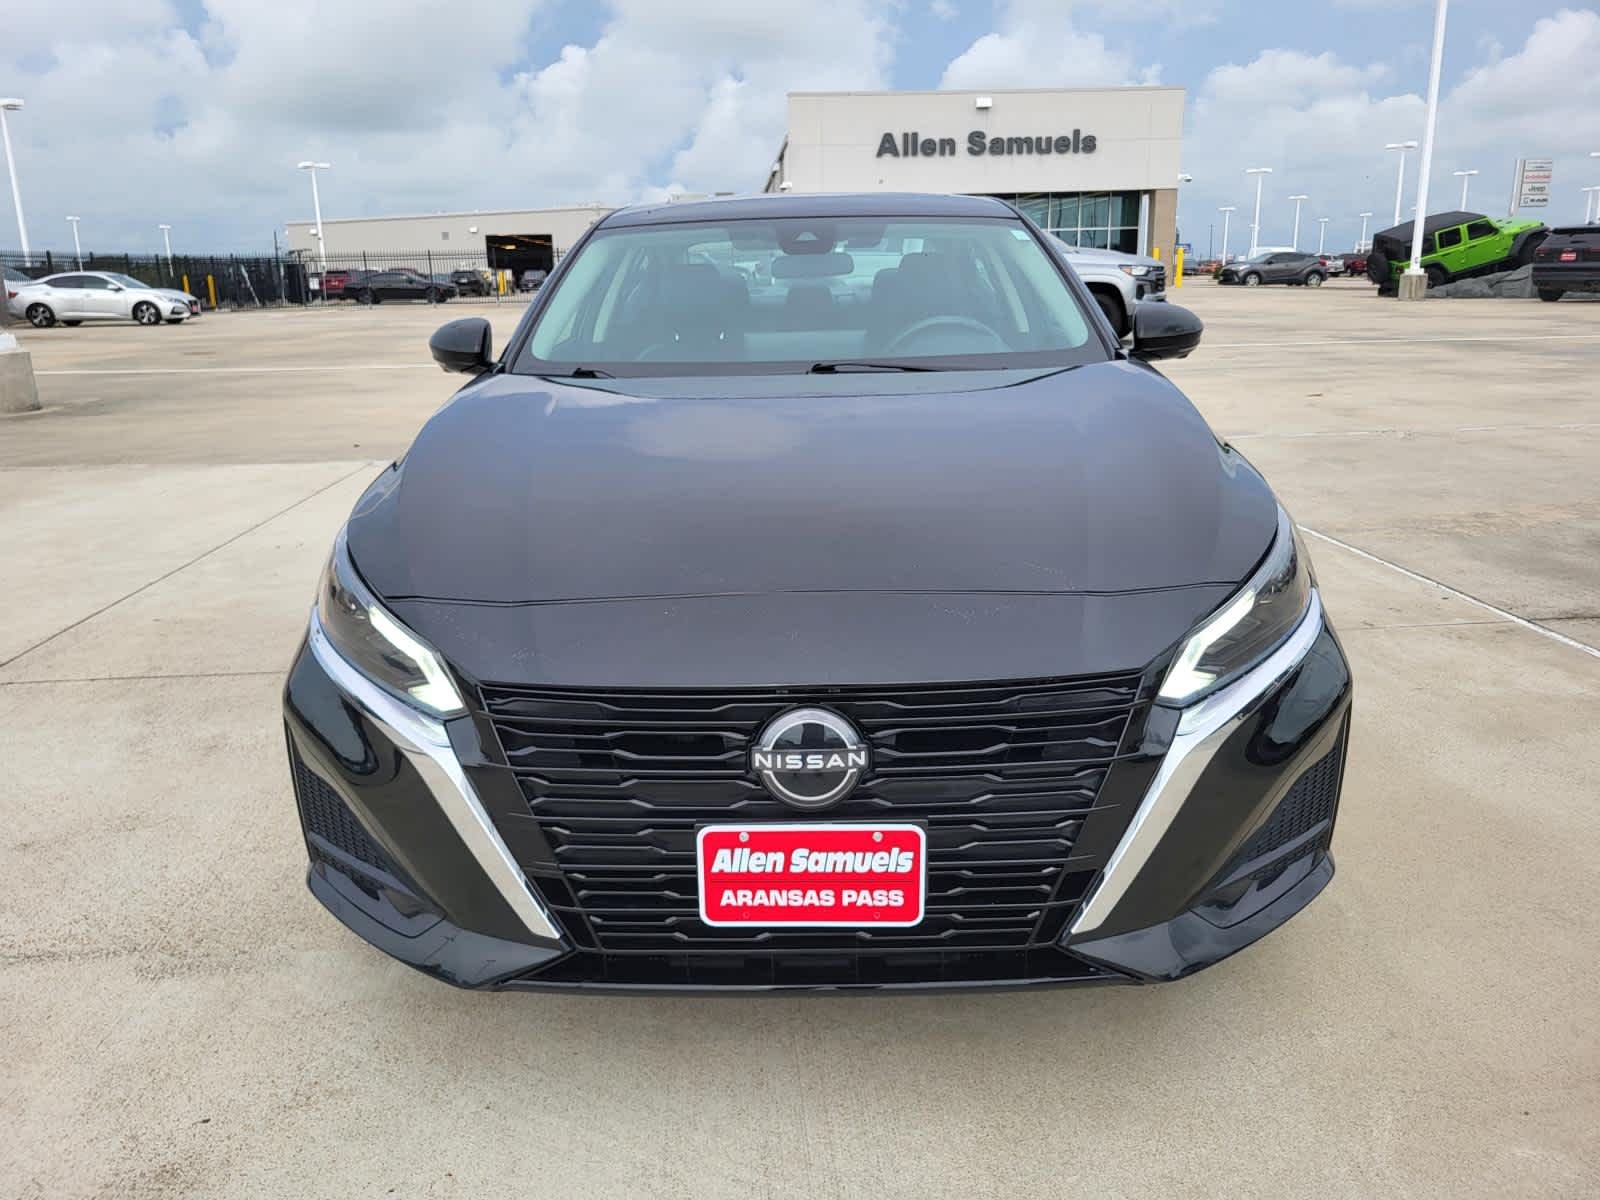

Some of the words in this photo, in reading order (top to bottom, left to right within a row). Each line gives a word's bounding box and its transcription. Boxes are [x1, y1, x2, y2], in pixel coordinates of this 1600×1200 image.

[876, 131, 956, 158] Allen
[967, 129, 1097, 156] Samuels
[754, 750, 866, 769] NISSAN
[711, 847, 785, 874] Allen
[789, 847, 914, 874] Samuels
[720, 889, 836, 907] ARANSAS
[842, 889, 905, 907] PASS
